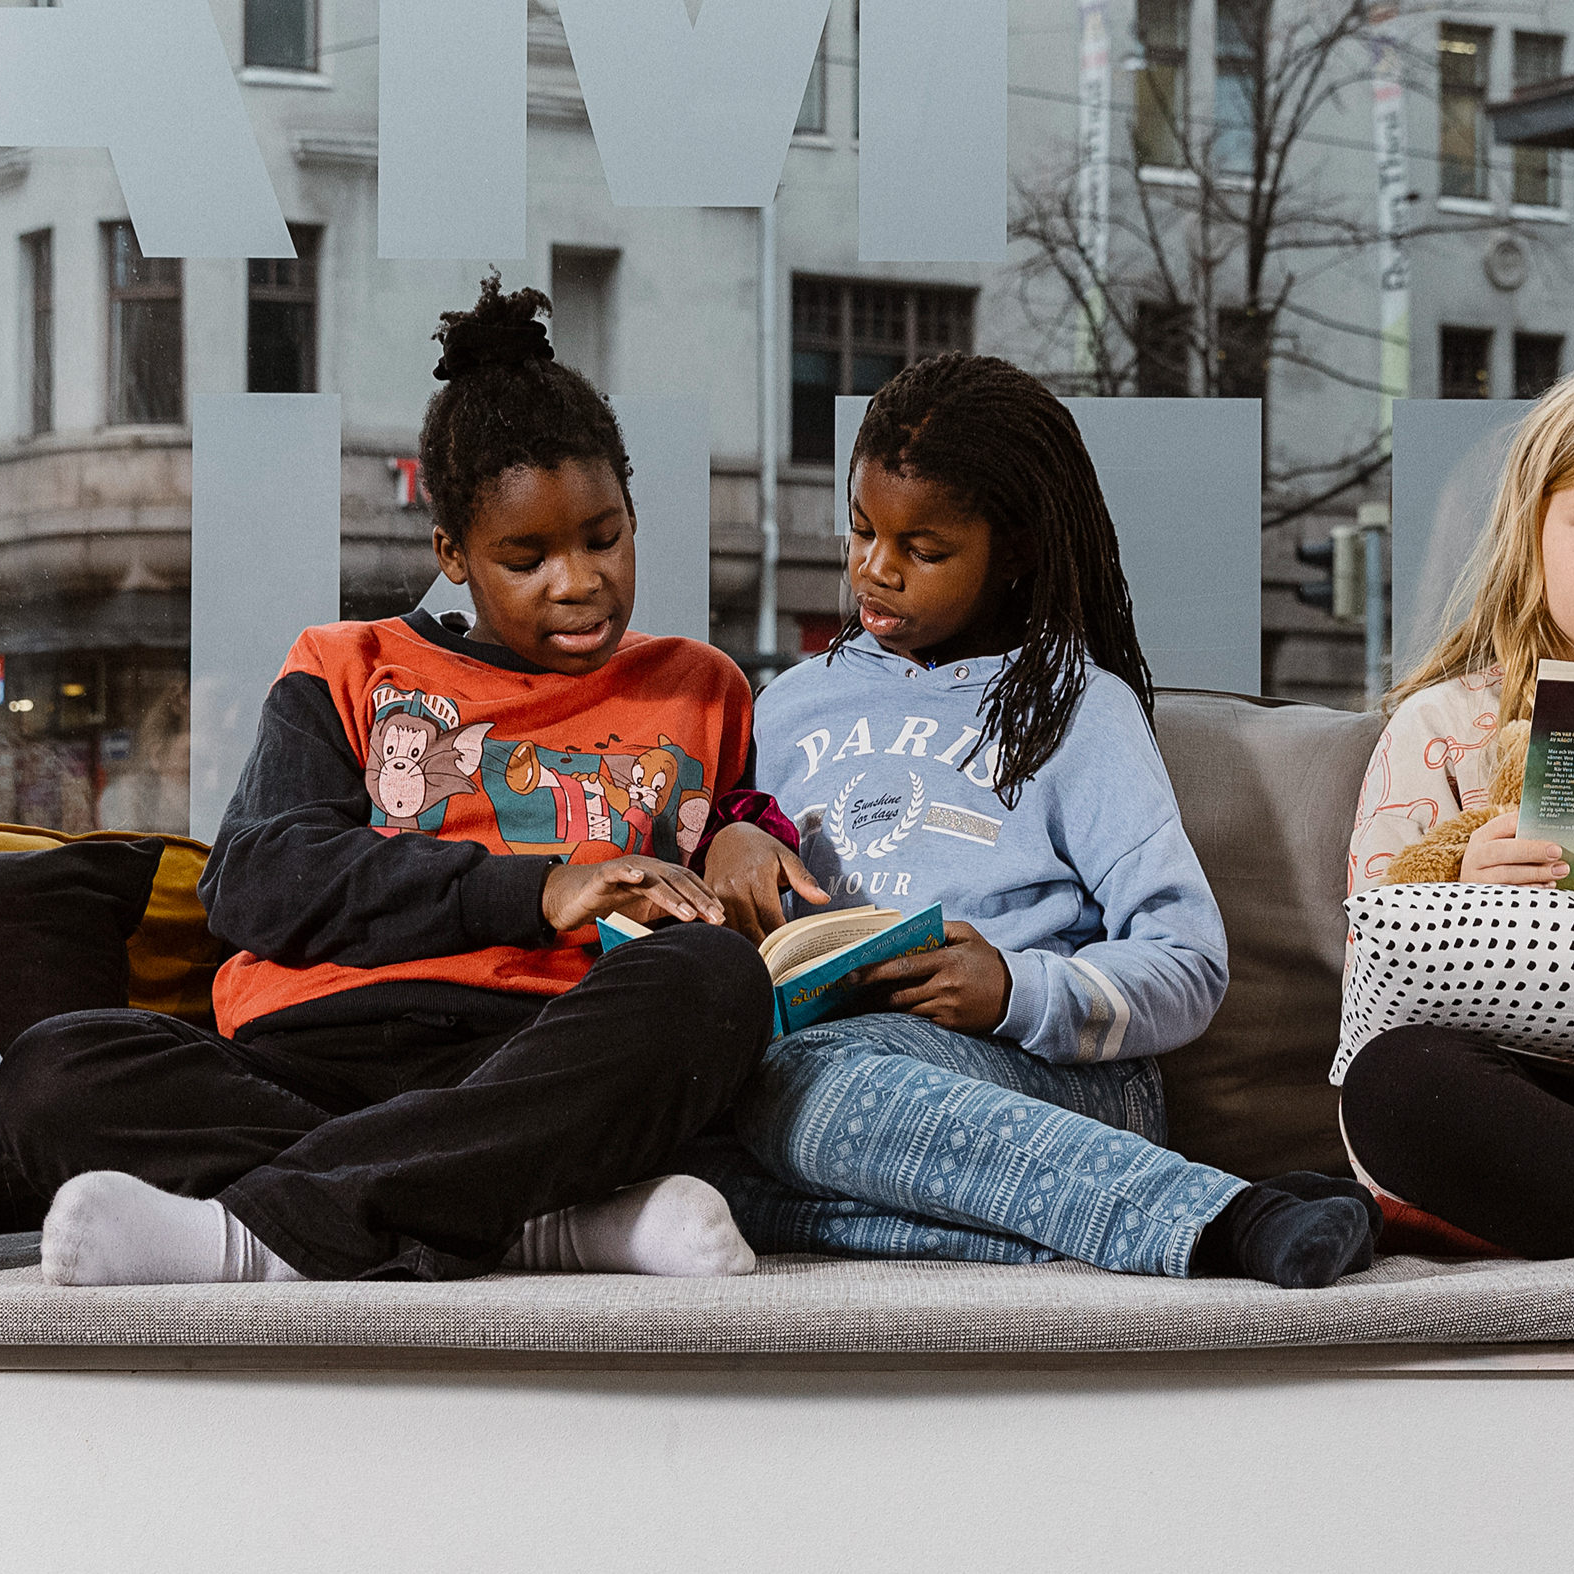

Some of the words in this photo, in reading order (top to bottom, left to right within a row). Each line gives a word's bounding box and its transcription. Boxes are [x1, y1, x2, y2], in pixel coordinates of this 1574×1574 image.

[796, 716, 1003, 788] PARIS
[851, 792, 902, 814] Sunshine
[852, 812, 869, 830] for
[872, 808, 900, 823] days
[827, 871, 912, 896] MOUR
[897, 918, 932, 939] Solberg
